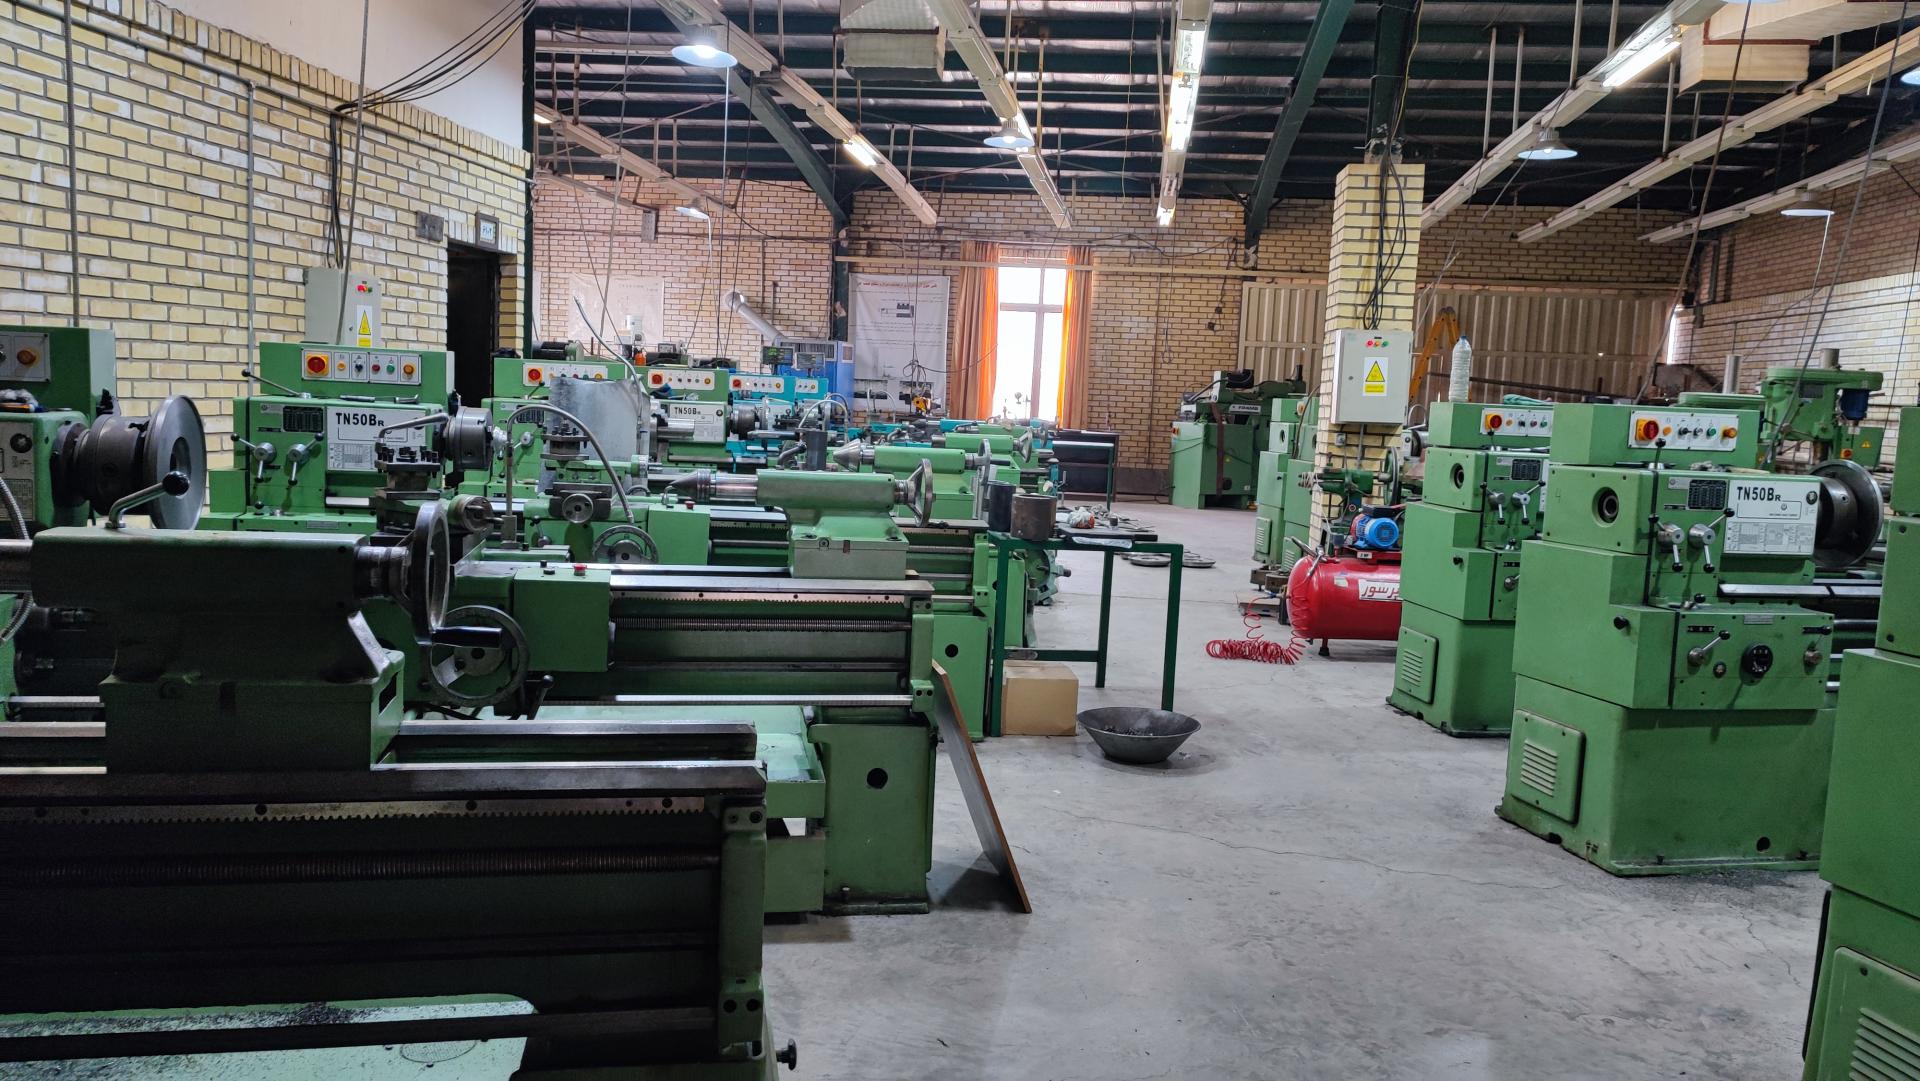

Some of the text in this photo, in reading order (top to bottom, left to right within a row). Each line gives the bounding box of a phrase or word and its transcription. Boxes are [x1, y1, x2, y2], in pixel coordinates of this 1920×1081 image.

[336, 413, 385, 427] TN50BR
[1737, 486, 1782, 502] TN50BR
[1361, 585, 1400, 600] پرسور
